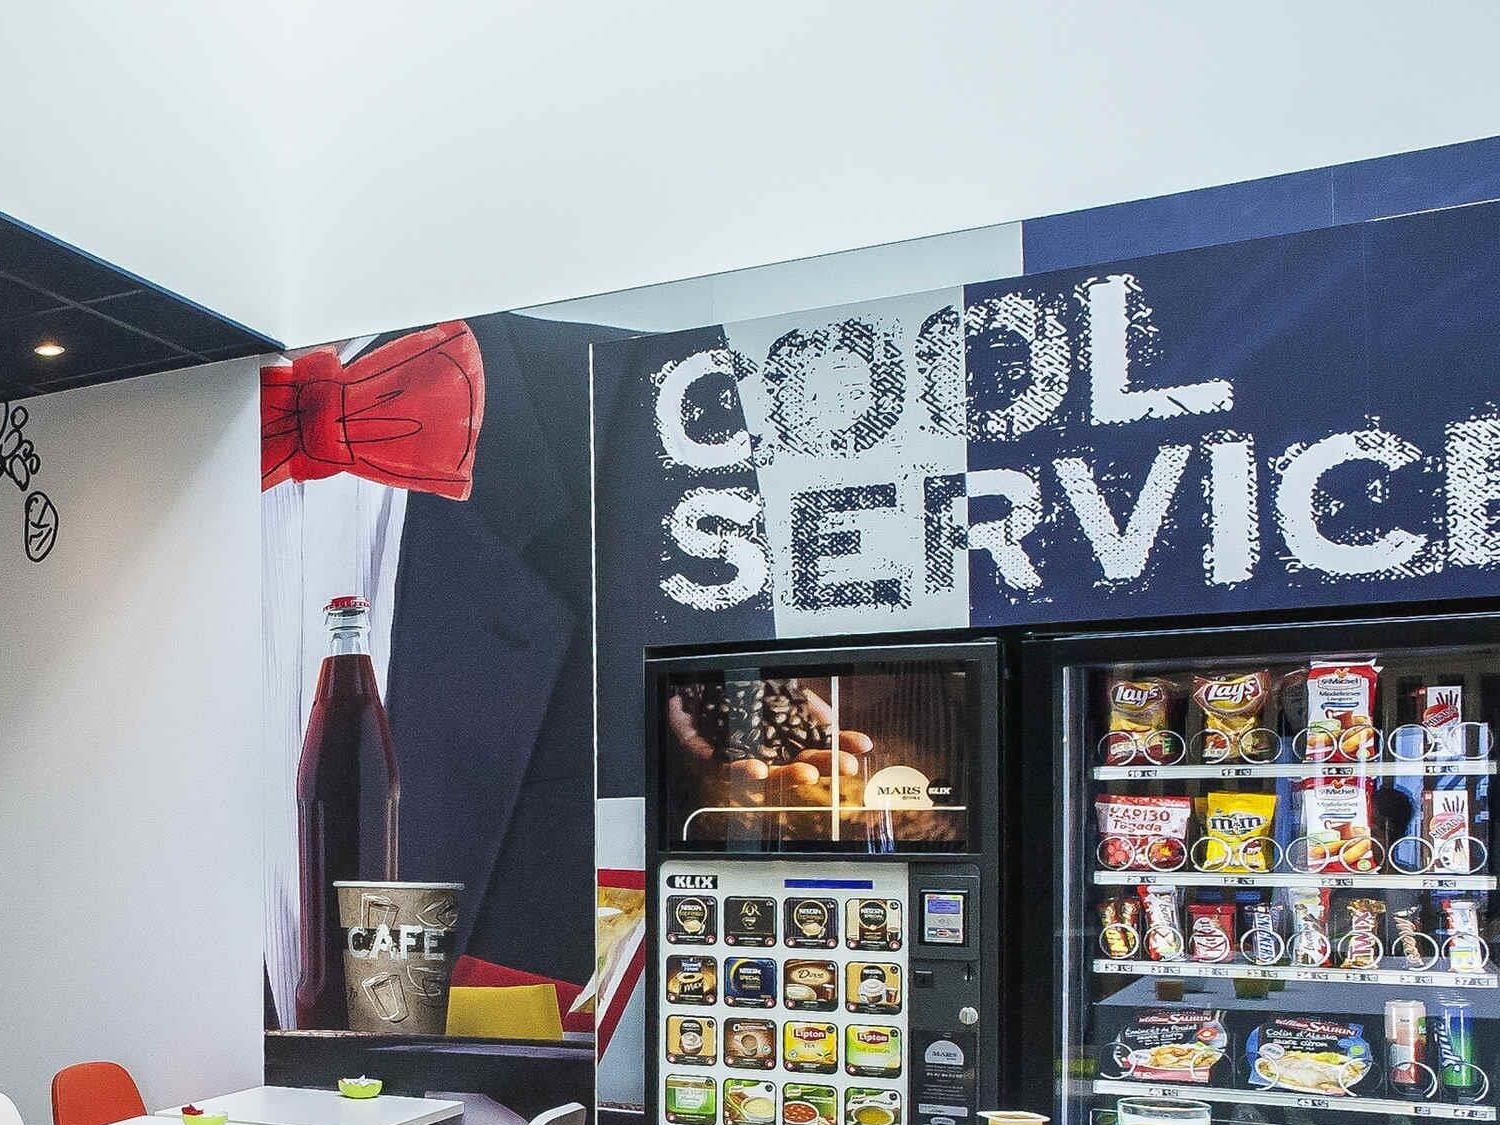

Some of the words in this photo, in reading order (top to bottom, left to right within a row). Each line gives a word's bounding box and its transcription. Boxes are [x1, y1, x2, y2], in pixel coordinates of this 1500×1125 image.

[654, 274, 1235, 460] COOL
[877, 787, 921, 795] MARS
[928, 787, 952, 795] KLIX
[1112, 819, 1162, 833] Tagada
[674, 876, 714, 889] KLIX
[1257, 913, 1274, 962] SNICKERS
[1350, 911, 1375, 958] TWIX
[347, 924, 445, 962] CAFE
[795, 1029, 825, 1039] Lipton
[858, 1033, 888, 1042] Lipton
[1434, 1015, 1463, 1073] Sprite
